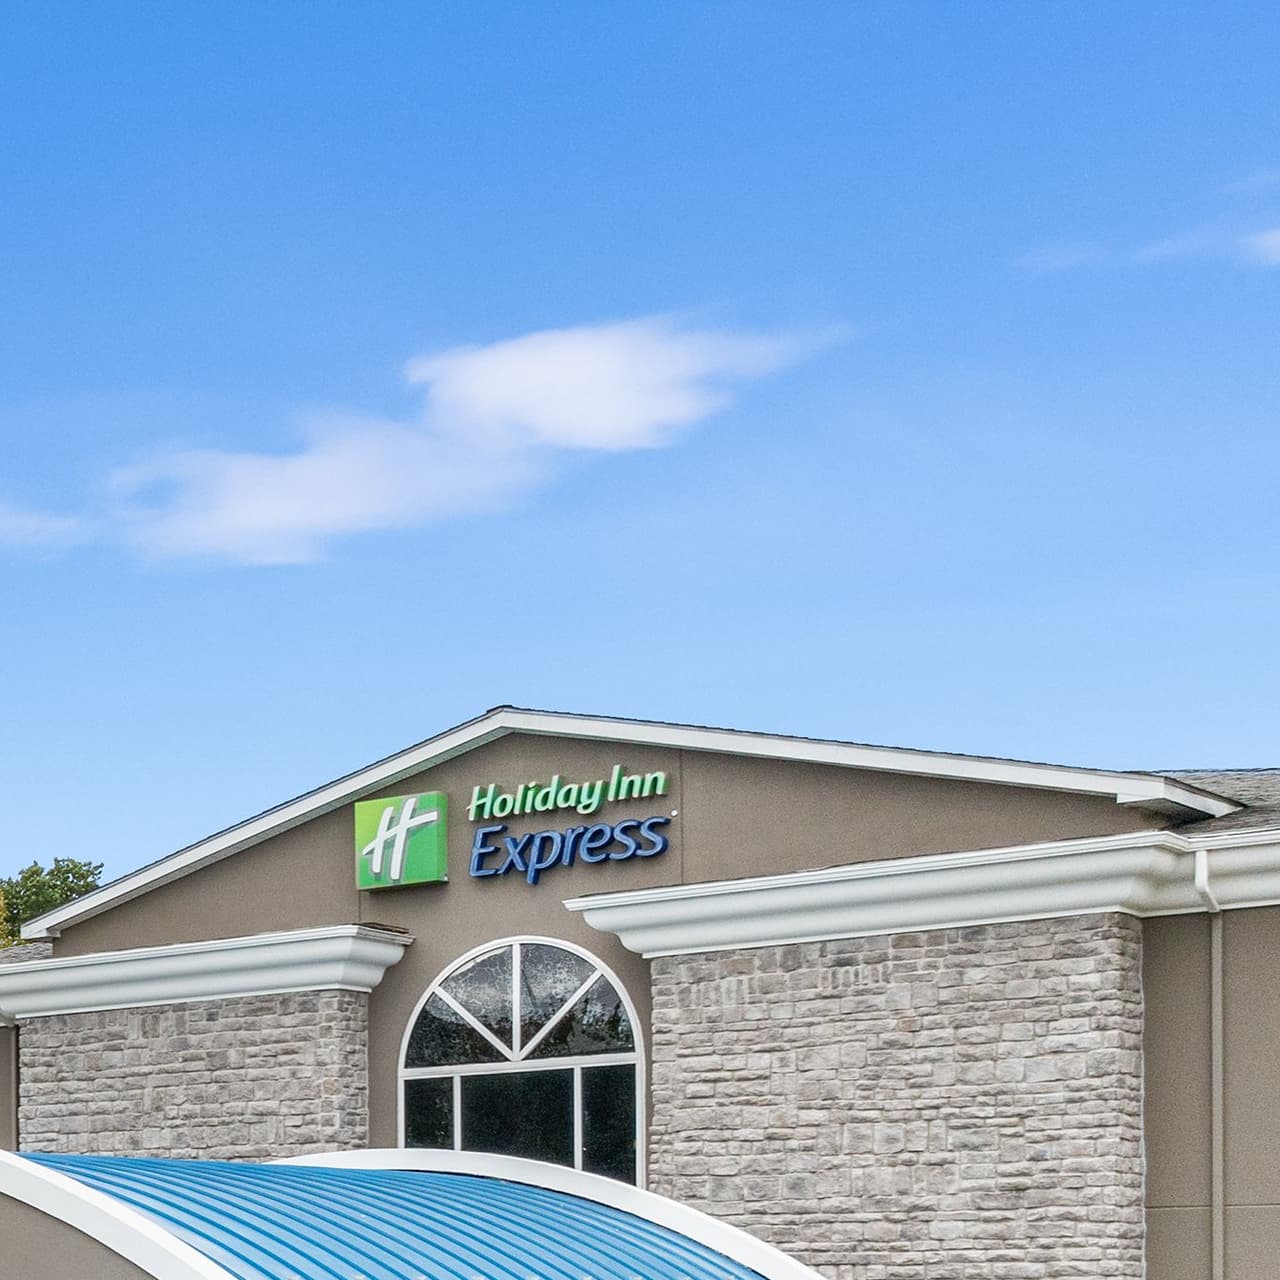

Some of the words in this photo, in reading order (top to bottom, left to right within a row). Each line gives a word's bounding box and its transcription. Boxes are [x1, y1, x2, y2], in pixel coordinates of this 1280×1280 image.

[466, 775, 605, 821] Holiday
[607, 764, 669, 802] Inn
[362, 798, 438, 881] H
[468, 816, 672, 885] Express
